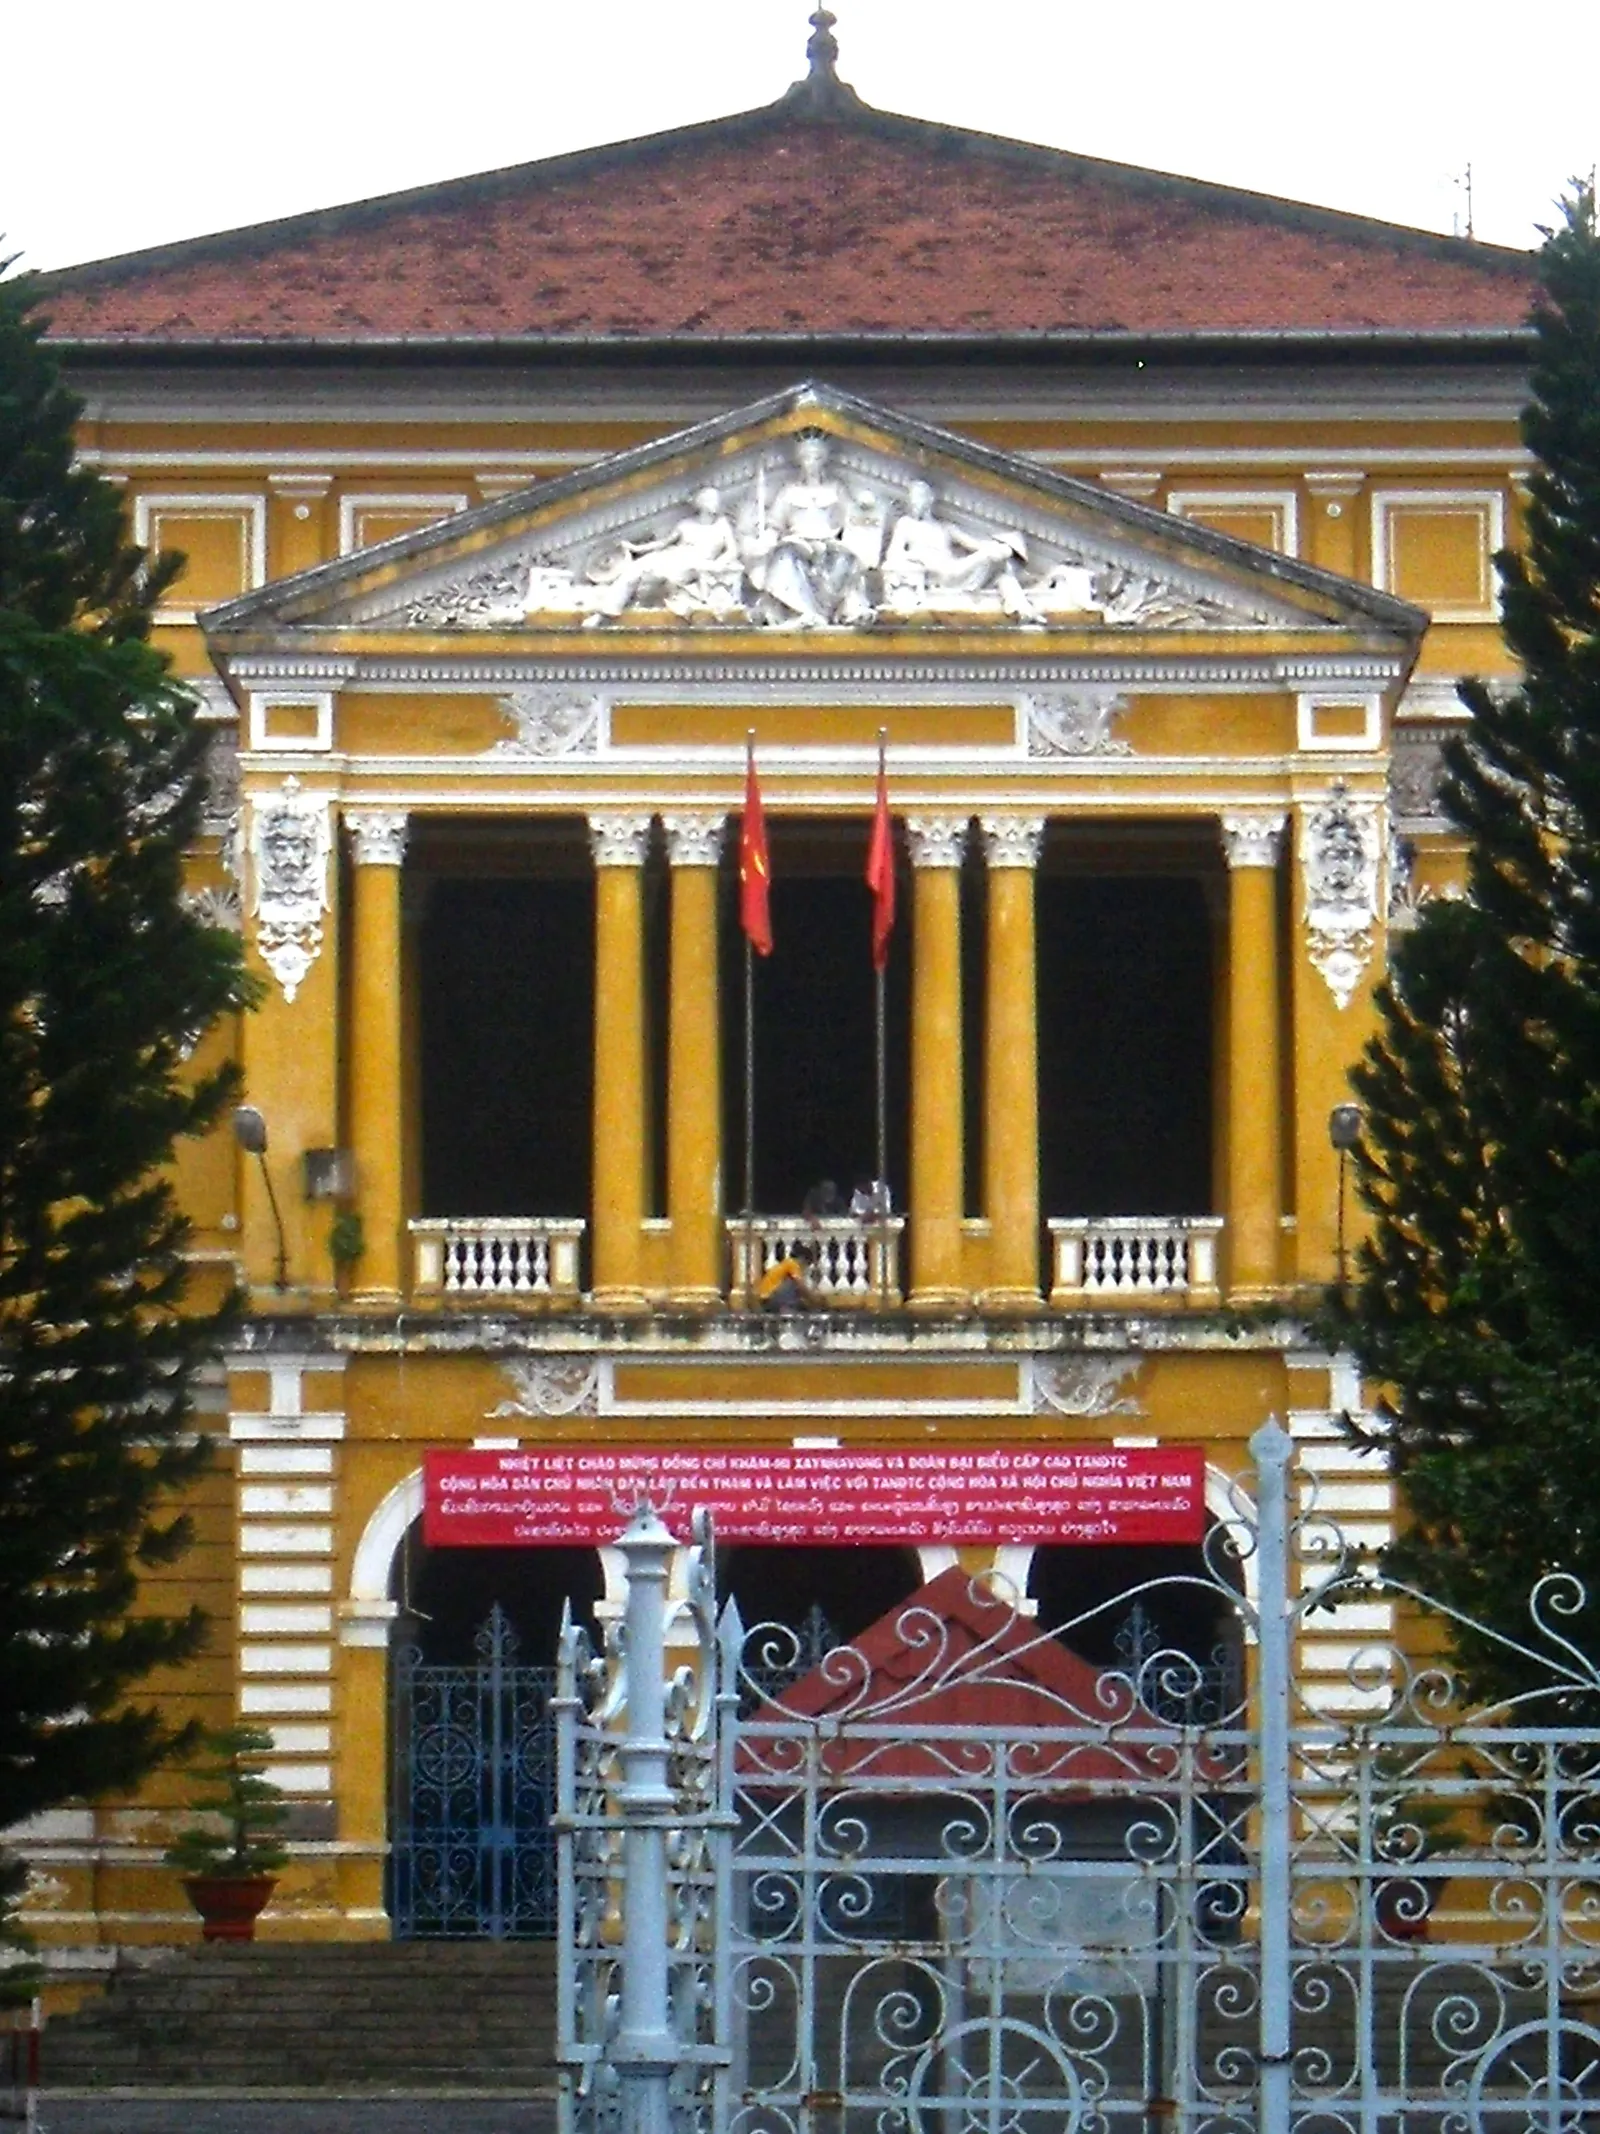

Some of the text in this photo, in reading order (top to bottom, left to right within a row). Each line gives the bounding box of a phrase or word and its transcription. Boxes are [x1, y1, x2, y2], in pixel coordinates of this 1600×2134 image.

[887, 1455, 905, 1469] VÀ
[1043, 1456, 1071, 1468] CAO
[755, 1475, 772, 1489] VÀ
[1161, 1475, 1192, 1488] NAM
